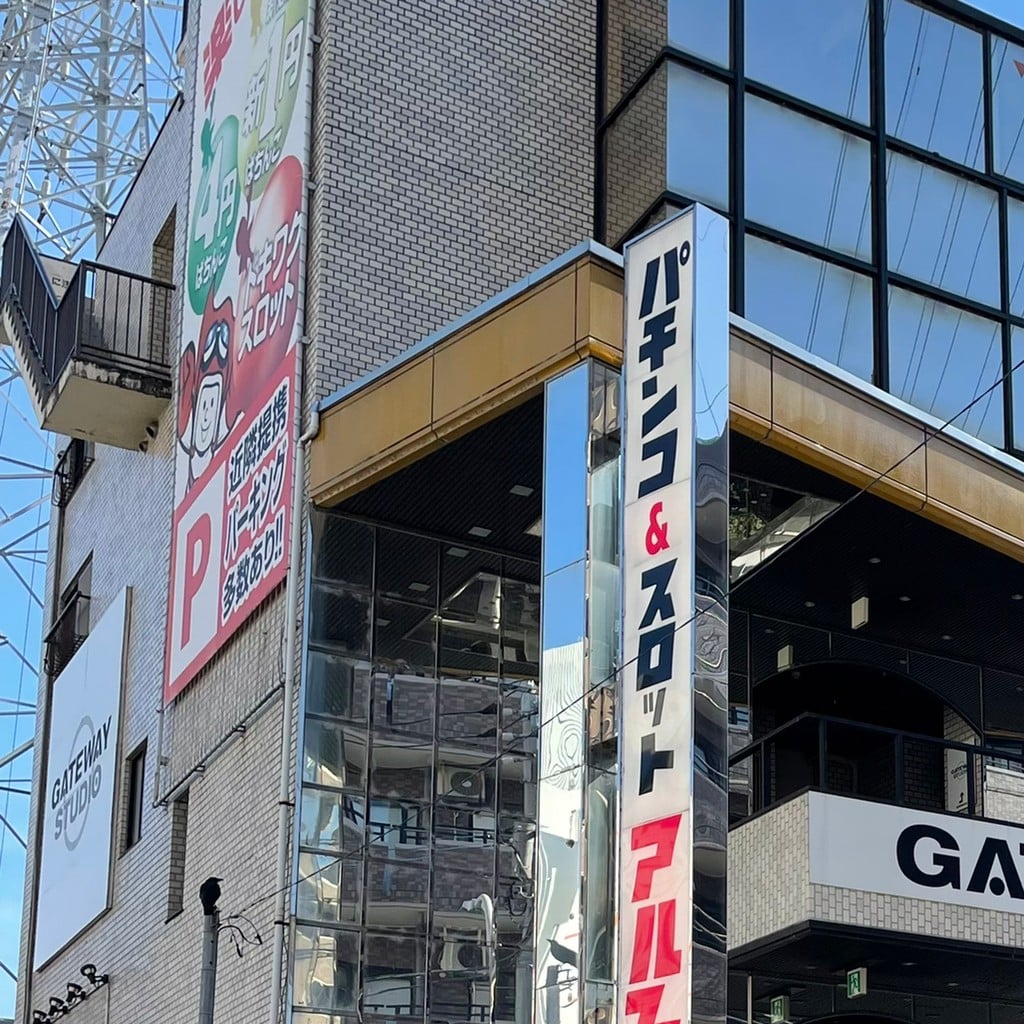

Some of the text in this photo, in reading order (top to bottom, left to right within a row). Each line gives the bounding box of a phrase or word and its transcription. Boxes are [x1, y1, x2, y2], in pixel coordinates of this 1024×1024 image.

[194, 136, 238, 250] 4円
[238, 269, 295, 362] スロット
[228, 384, 289, 496] 近隣提携
[226, 440, 287, 560] パーキング
[180, 512, 212, 651] P
[51, 714, 112, 810] GATEWAY
[54, 763, 102, 841] STUDIO
